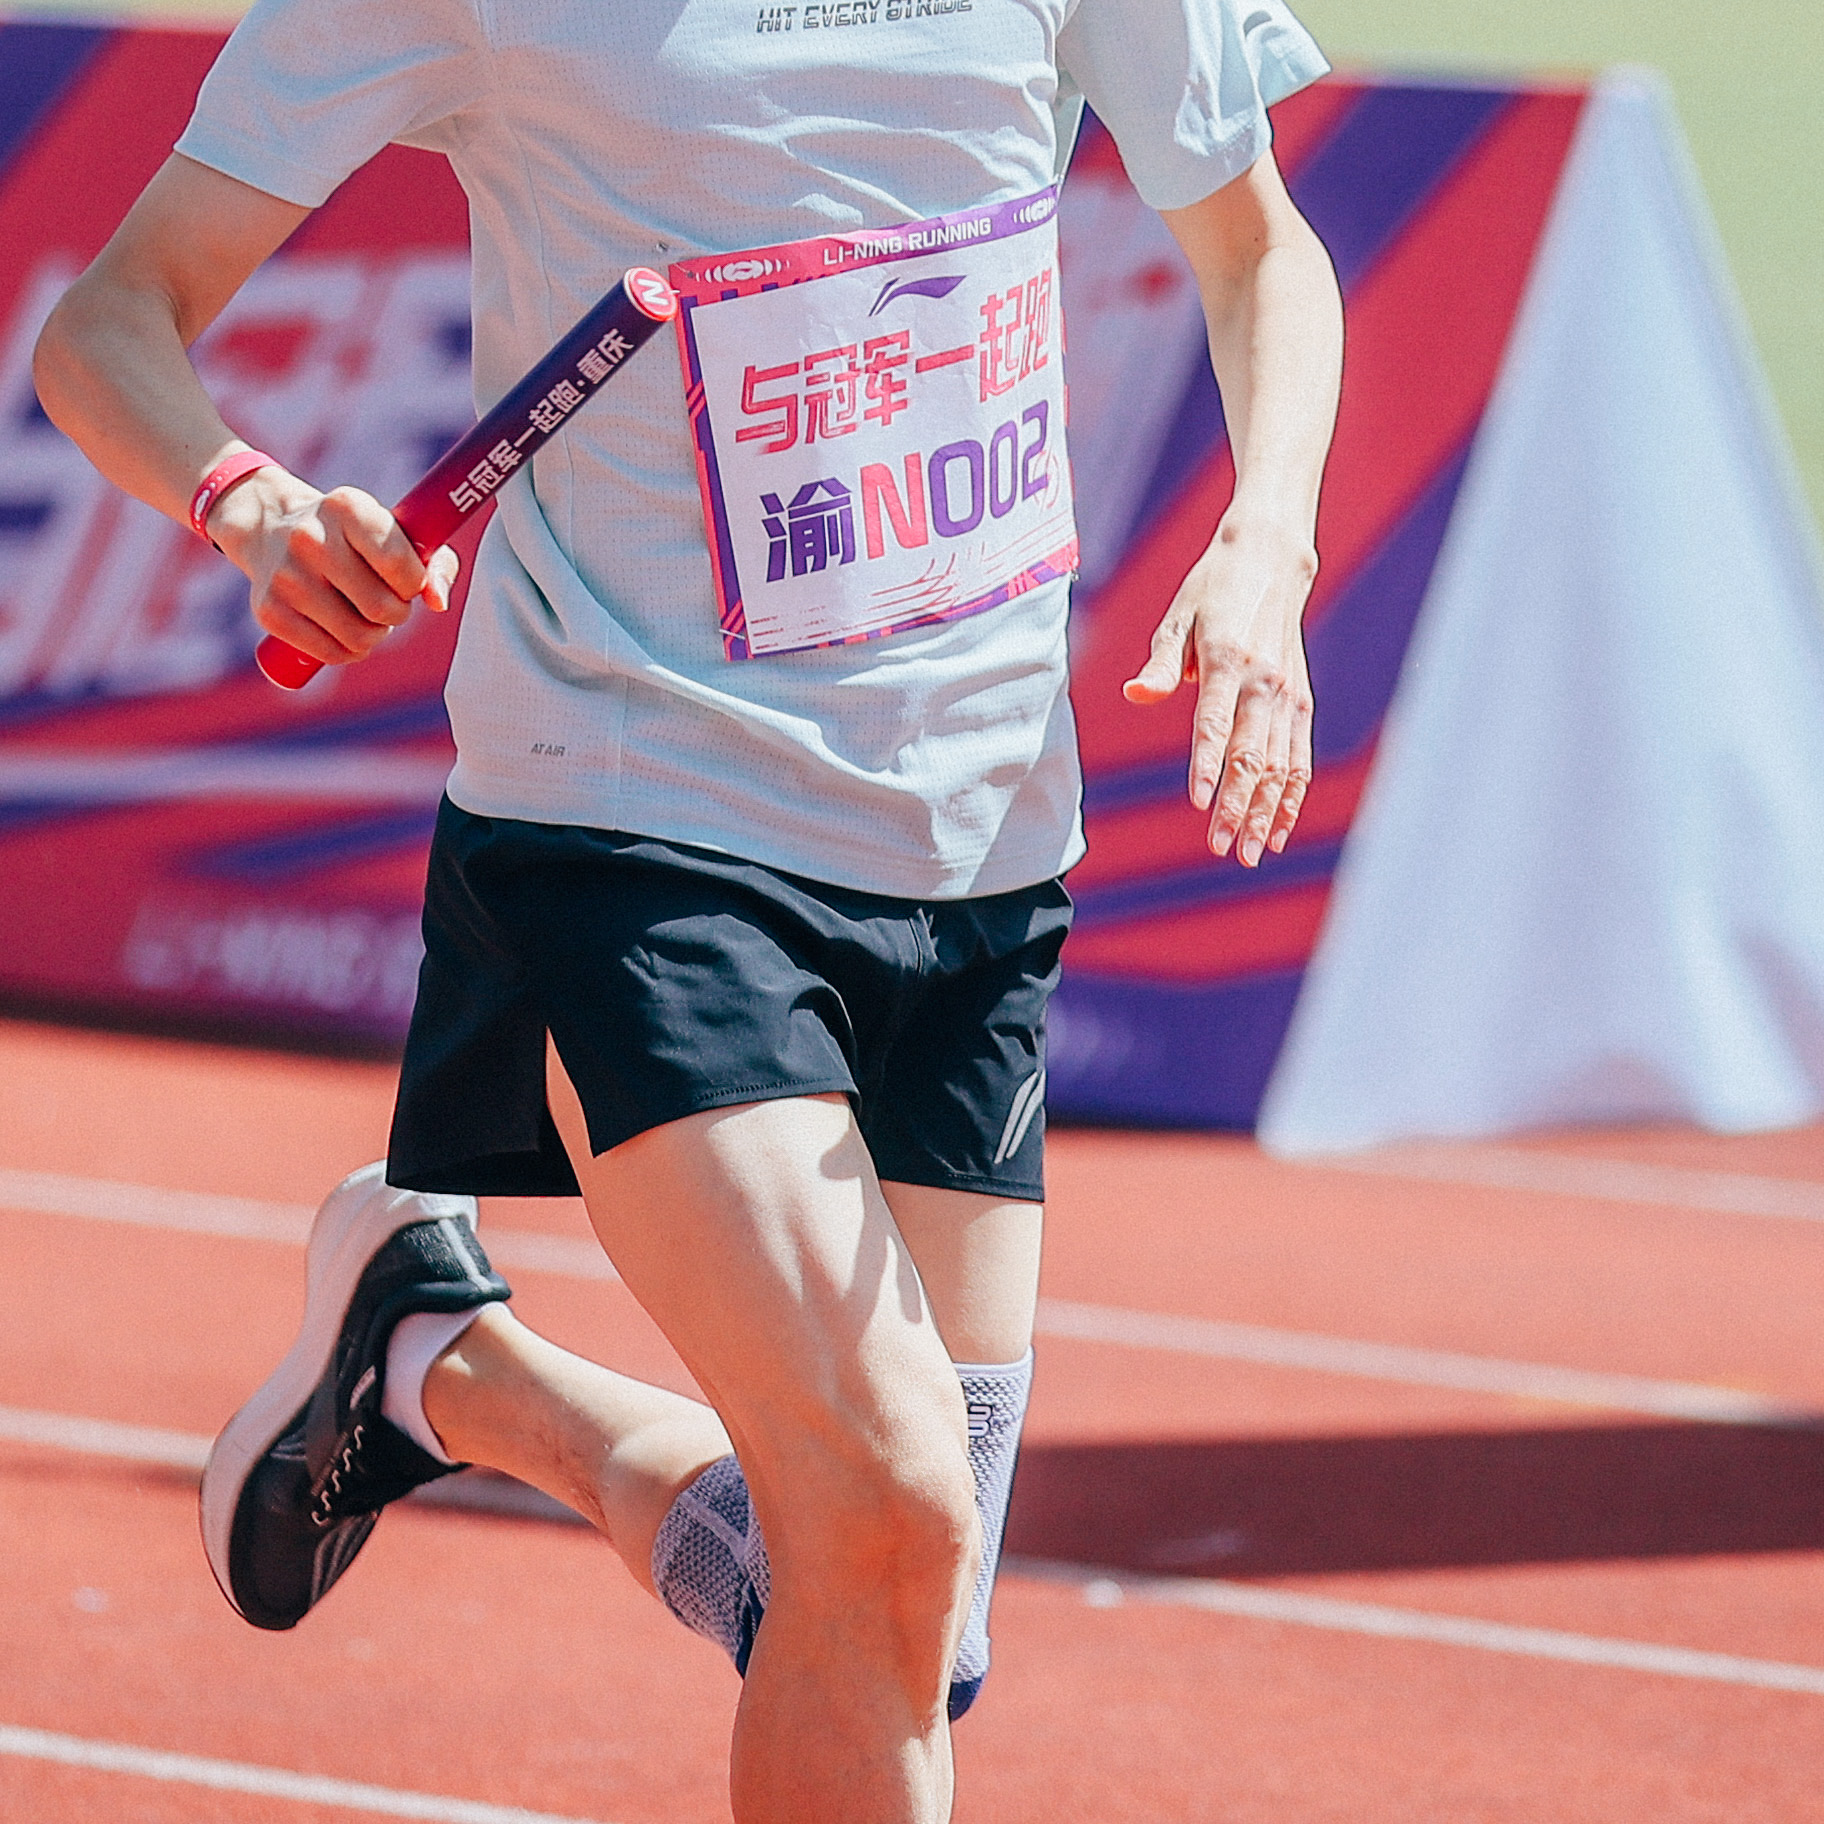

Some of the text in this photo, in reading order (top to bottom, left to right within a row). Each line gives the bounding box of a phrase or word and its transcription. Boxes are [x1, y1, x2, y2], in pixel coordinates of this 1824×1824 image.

[756, 7, 797, 33] HIT
[803, 0, 880, 29] EVERY
[823, 217, 992, 266] LI-NING RUNNING
[735, 267, 1053, 456] 与冠军一起跑
[759, 399, 1051, 583] 渝N002
